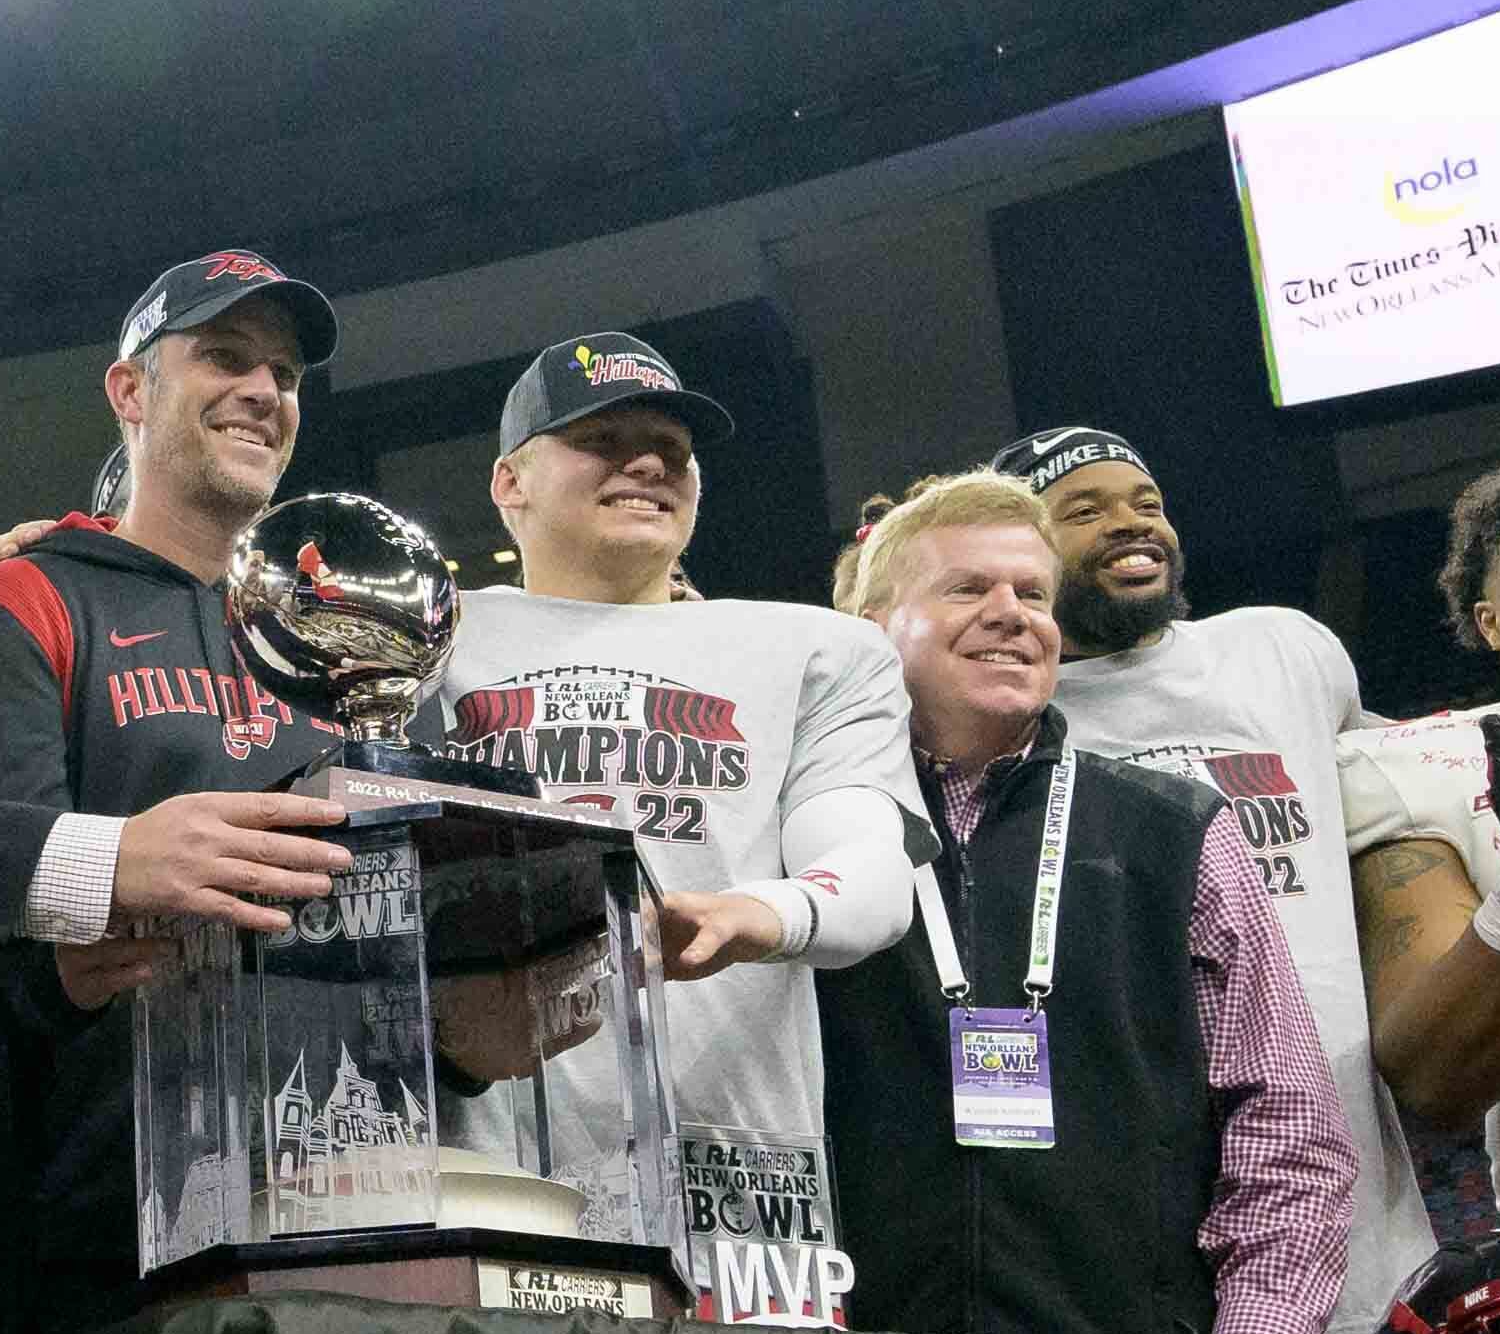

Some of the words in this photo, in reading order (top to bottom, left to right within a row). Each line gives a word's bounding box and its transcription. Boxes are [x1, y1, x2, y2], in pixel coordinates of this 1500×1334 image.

[1393, 157, 1479, 202] nola
[1280, 275, 1339, 306] The
[544, 692, 571, 701] NEW
[575, 691, 631, 702] ORLEANS
[543, 699, 630, 722] BOWL
[345, 780, 382, 797] 2022
[633, 791, 708, 845] 22
[1046, 784, 1068, 836] ORLEANS
[966, 1052, 1038, 1072] BOWL
[743, 1148, 797, 1173] CARRIERS
[685, 1166, 728, 1190] NEW
[733, 1169, 820, 1197] ORLEANS
[689, 1187, 826, 1244] BOWL
[560, 1274, 607, 1299] CARRIERS
[713, 1240, 856, 1331] MVP
[1463, 1285, 1491, 1309] NIKE
[510, 1289, 551, 1312] NEW
